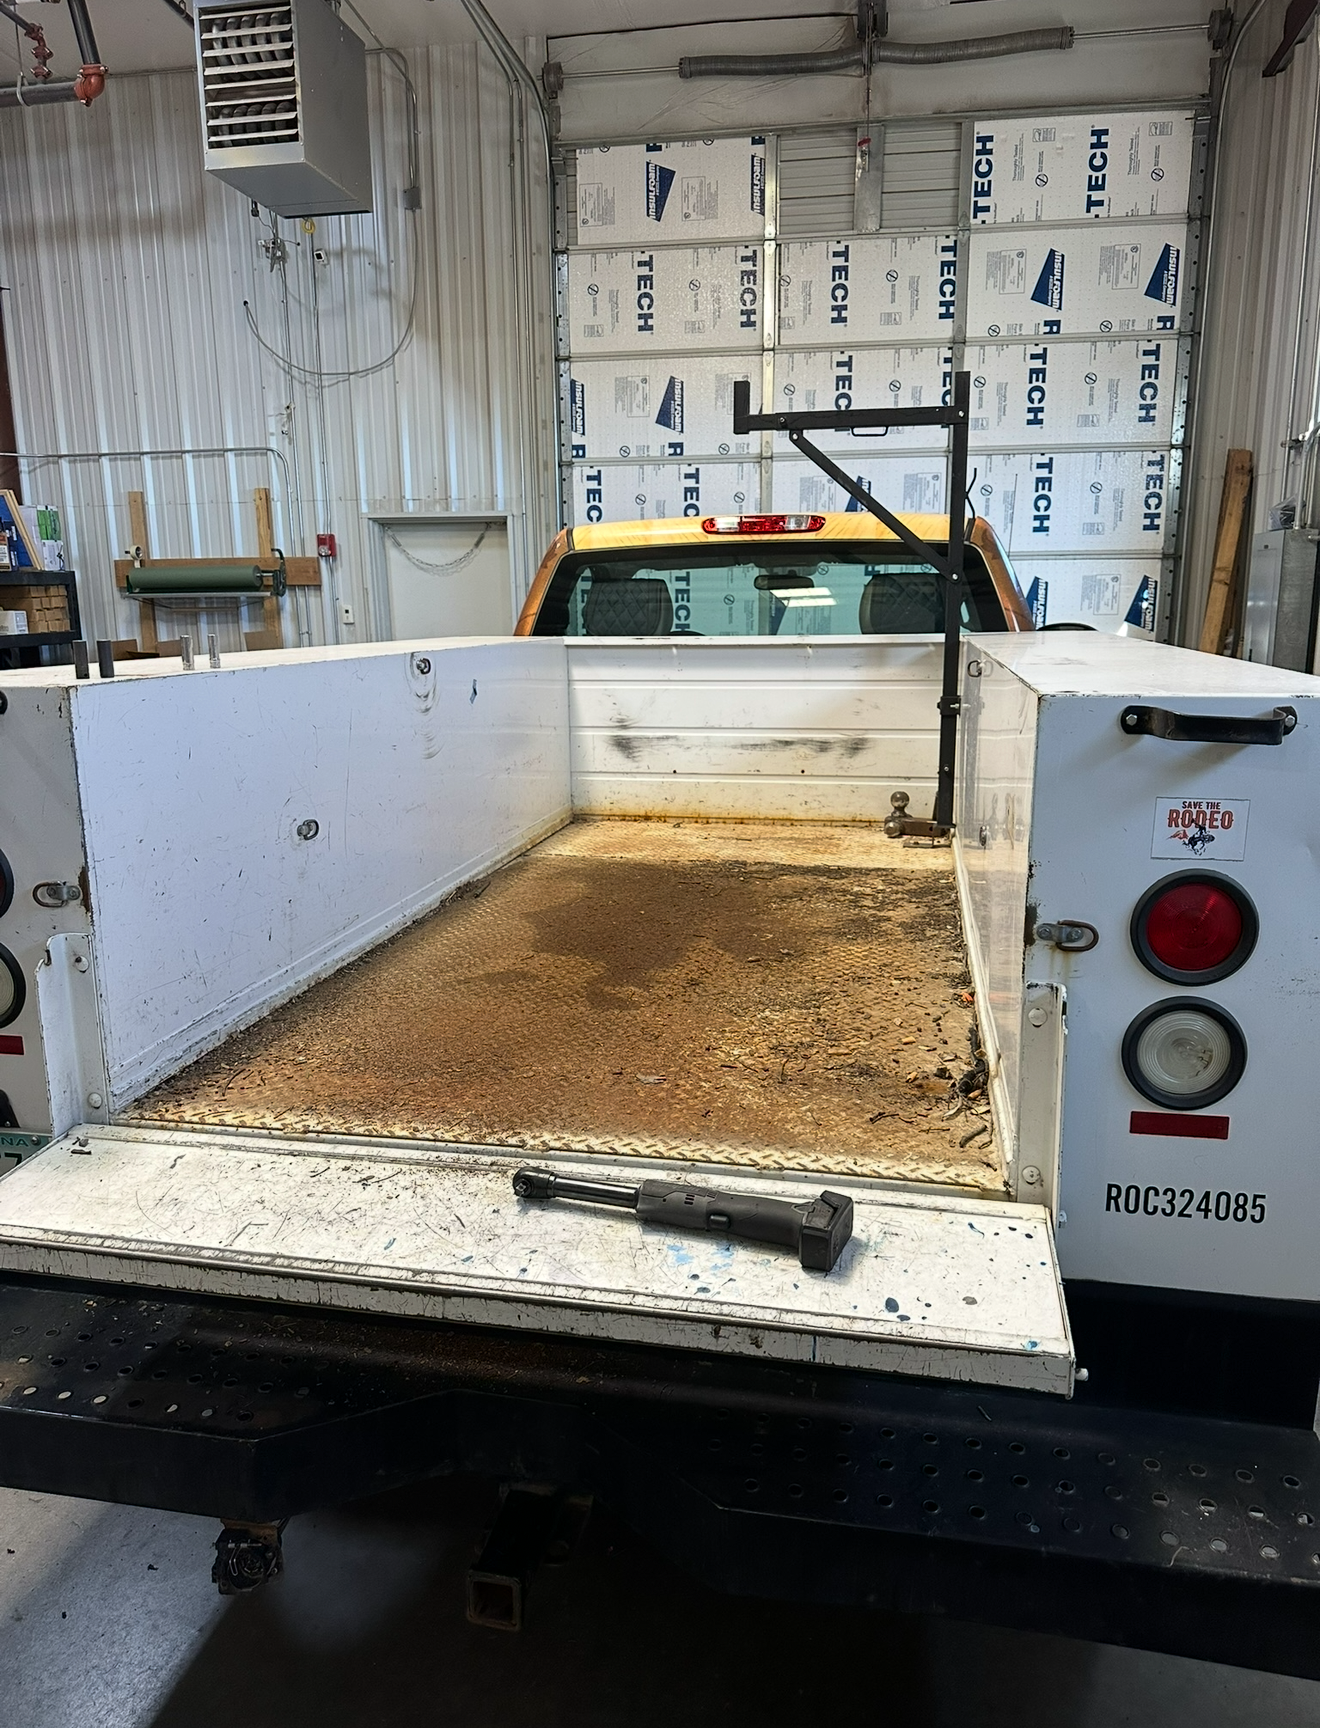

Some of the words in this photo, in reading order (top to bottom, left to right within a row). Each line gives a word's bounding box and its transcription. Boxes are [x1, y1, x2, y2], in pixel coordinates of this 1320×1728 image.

[972, 132, 995, 219] TECH
[1086, 126, 1110, 215] TECH
[637, 252, 654, 332] TECH
[739, 249, 757, 328] TECH
[831, 243, 850, 324] TECH
[936, 239, 956, 320] TECH
[835, 355, 853, 432] TEC
[1026, 347, 1048, 426] TECH
[1139, 343, 1161, 423] TECH
[586, 469, 603, 523] TEC
[1033, 456, 1054, 533] TECH
[1142, 454, 1166, 531] TECH
[1167, 809, 1234, 830] RODEO
[1182, 800, 1203, 810] SAVE
[1206, 801, 1221, 810] THE
[1105, 1183, 1267, 1224] ROC324085
